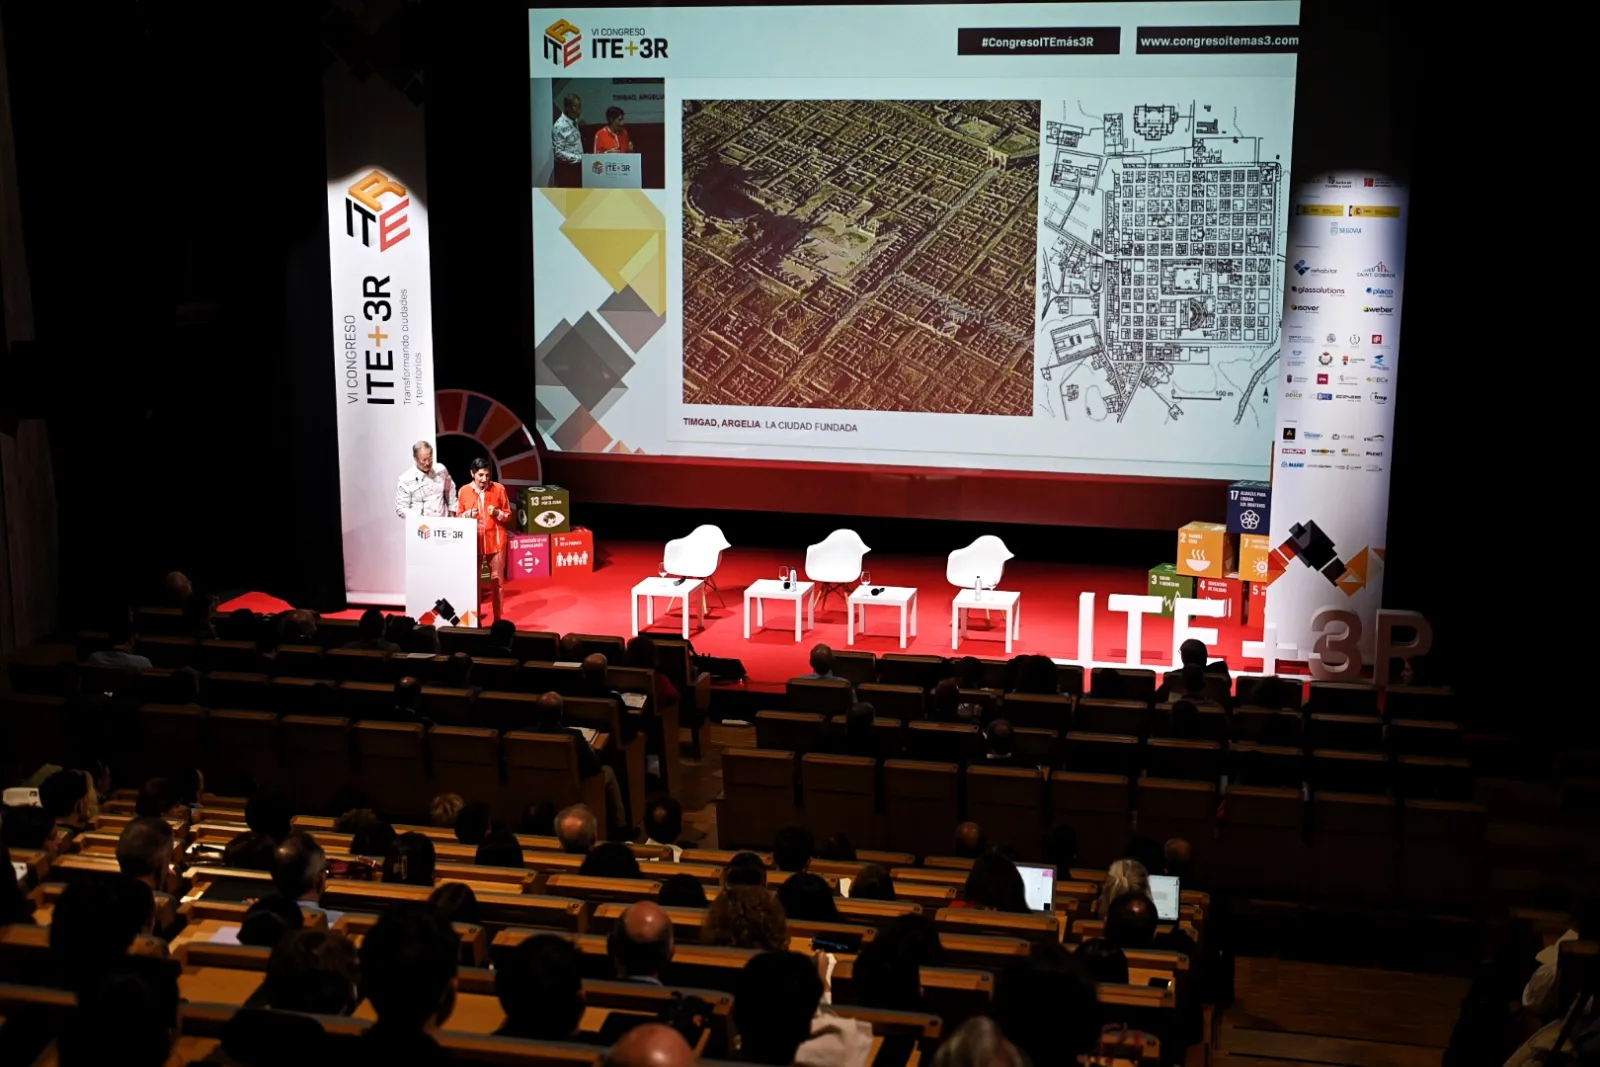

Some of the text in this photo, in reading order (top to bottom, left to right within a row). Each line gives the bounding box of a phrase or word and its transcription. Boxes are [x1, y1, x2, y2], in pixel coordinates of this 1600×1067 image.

[591, 28, 646, 37] VI CONGRESO
[592, 38, 669, 59] ITE+3R
[362, 275, 395, 405] ITE+3R
[399, 288, 412, 406] Transformando ciudades
[344, 314, 359, 405] VI CONGRESO
[414, 352, 424, 399] territorios
[683, 417, 720, 429] TIMGAD,
[765, 420, 777, 430] LA
[778, 421, 813, 431] CIUDAD
[814, 423, 858, 432] FUNDADA
[1230, 490, 1239, 500] 17
[530, 496, 540, 507] 13
[554, 537, 558, 547] 1
[1180, 533, 1186, 543] 2
[1244, 538, 1249, 548] 7
[509, 539, 519, 550] 10
[1151, 575, 1158, 585] 3
[1200, 580, 1206, 590] 4
[1252, 585, 1259, 596] 5
